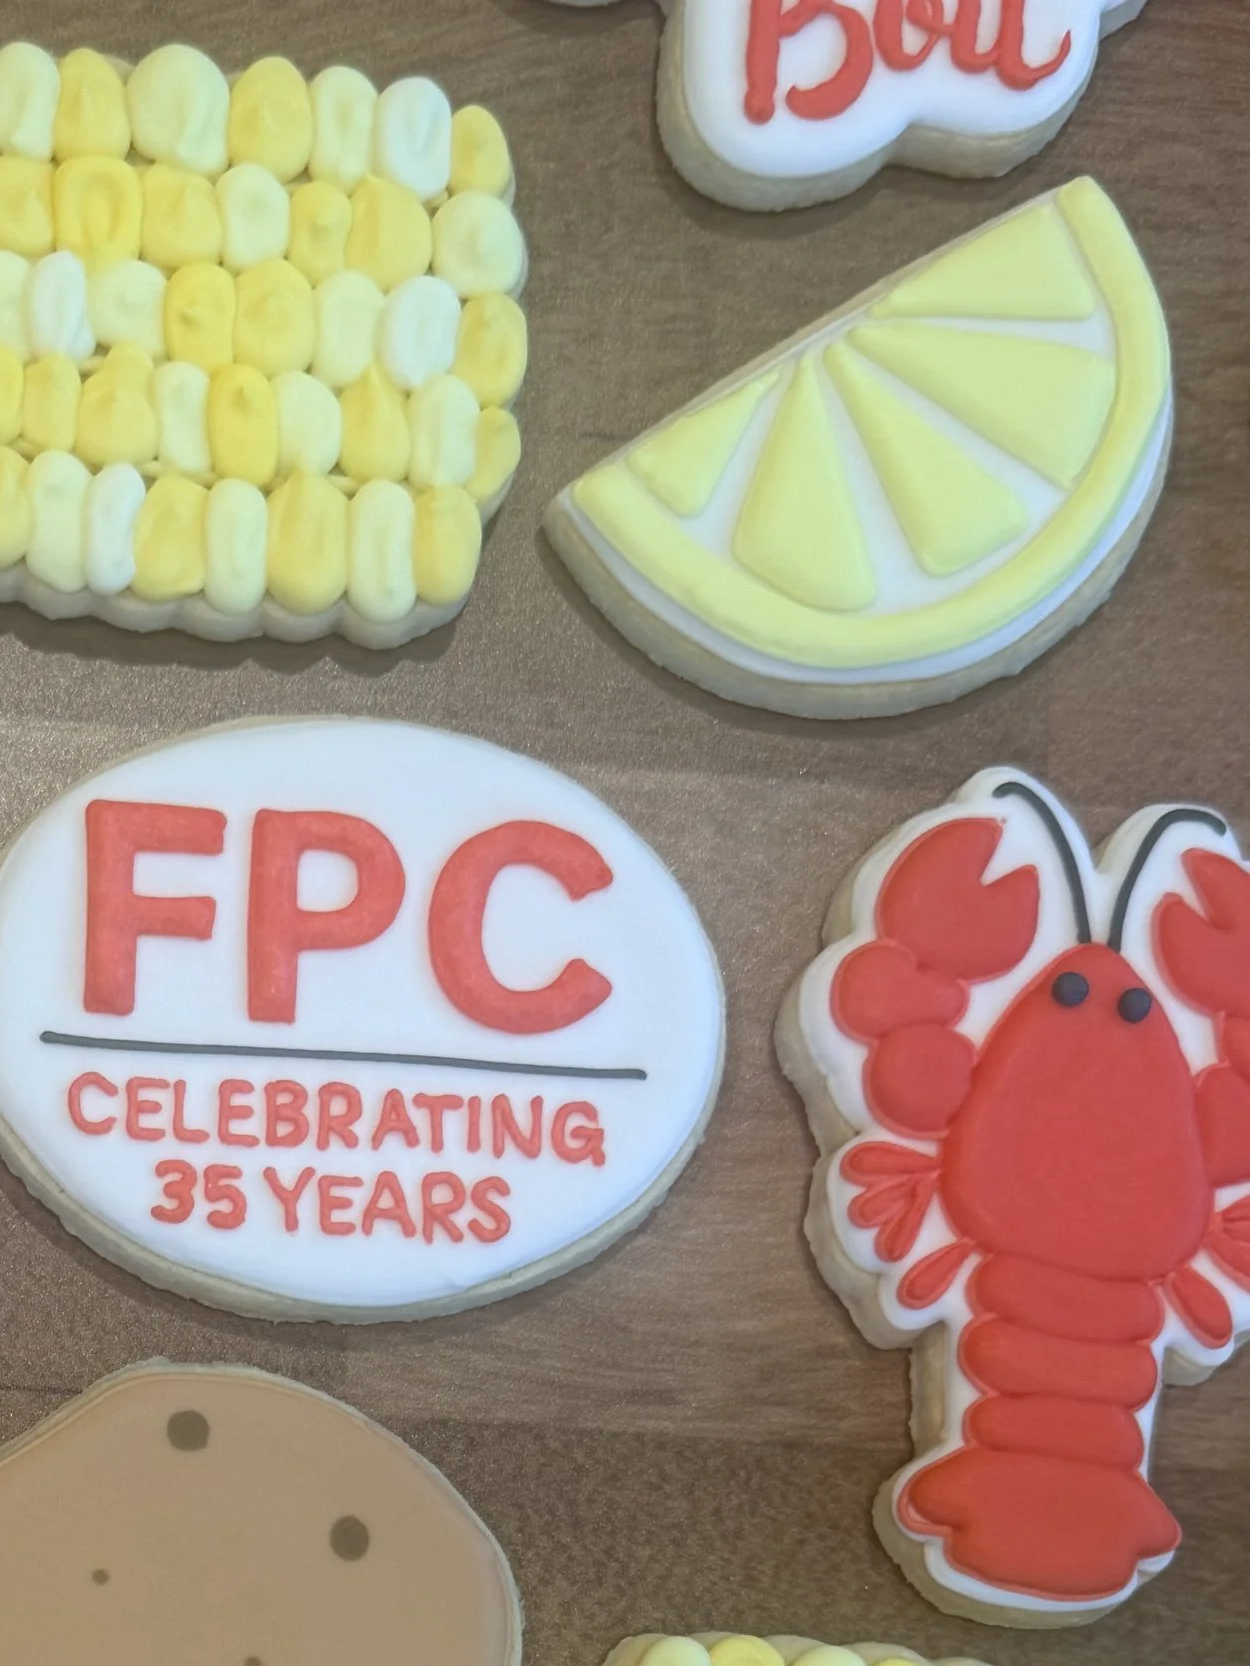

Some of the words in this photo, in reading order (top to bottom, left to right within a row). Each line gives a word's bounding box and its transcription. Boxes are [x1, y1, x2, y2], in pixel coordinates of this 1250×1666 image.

[83, 800, 613, 1035] FPC
[67, 1071, 606, 1167] CELEBRATING
[150, 1159, 247, 1230] 35
[263, 1167, 510, 1244] YEARS
